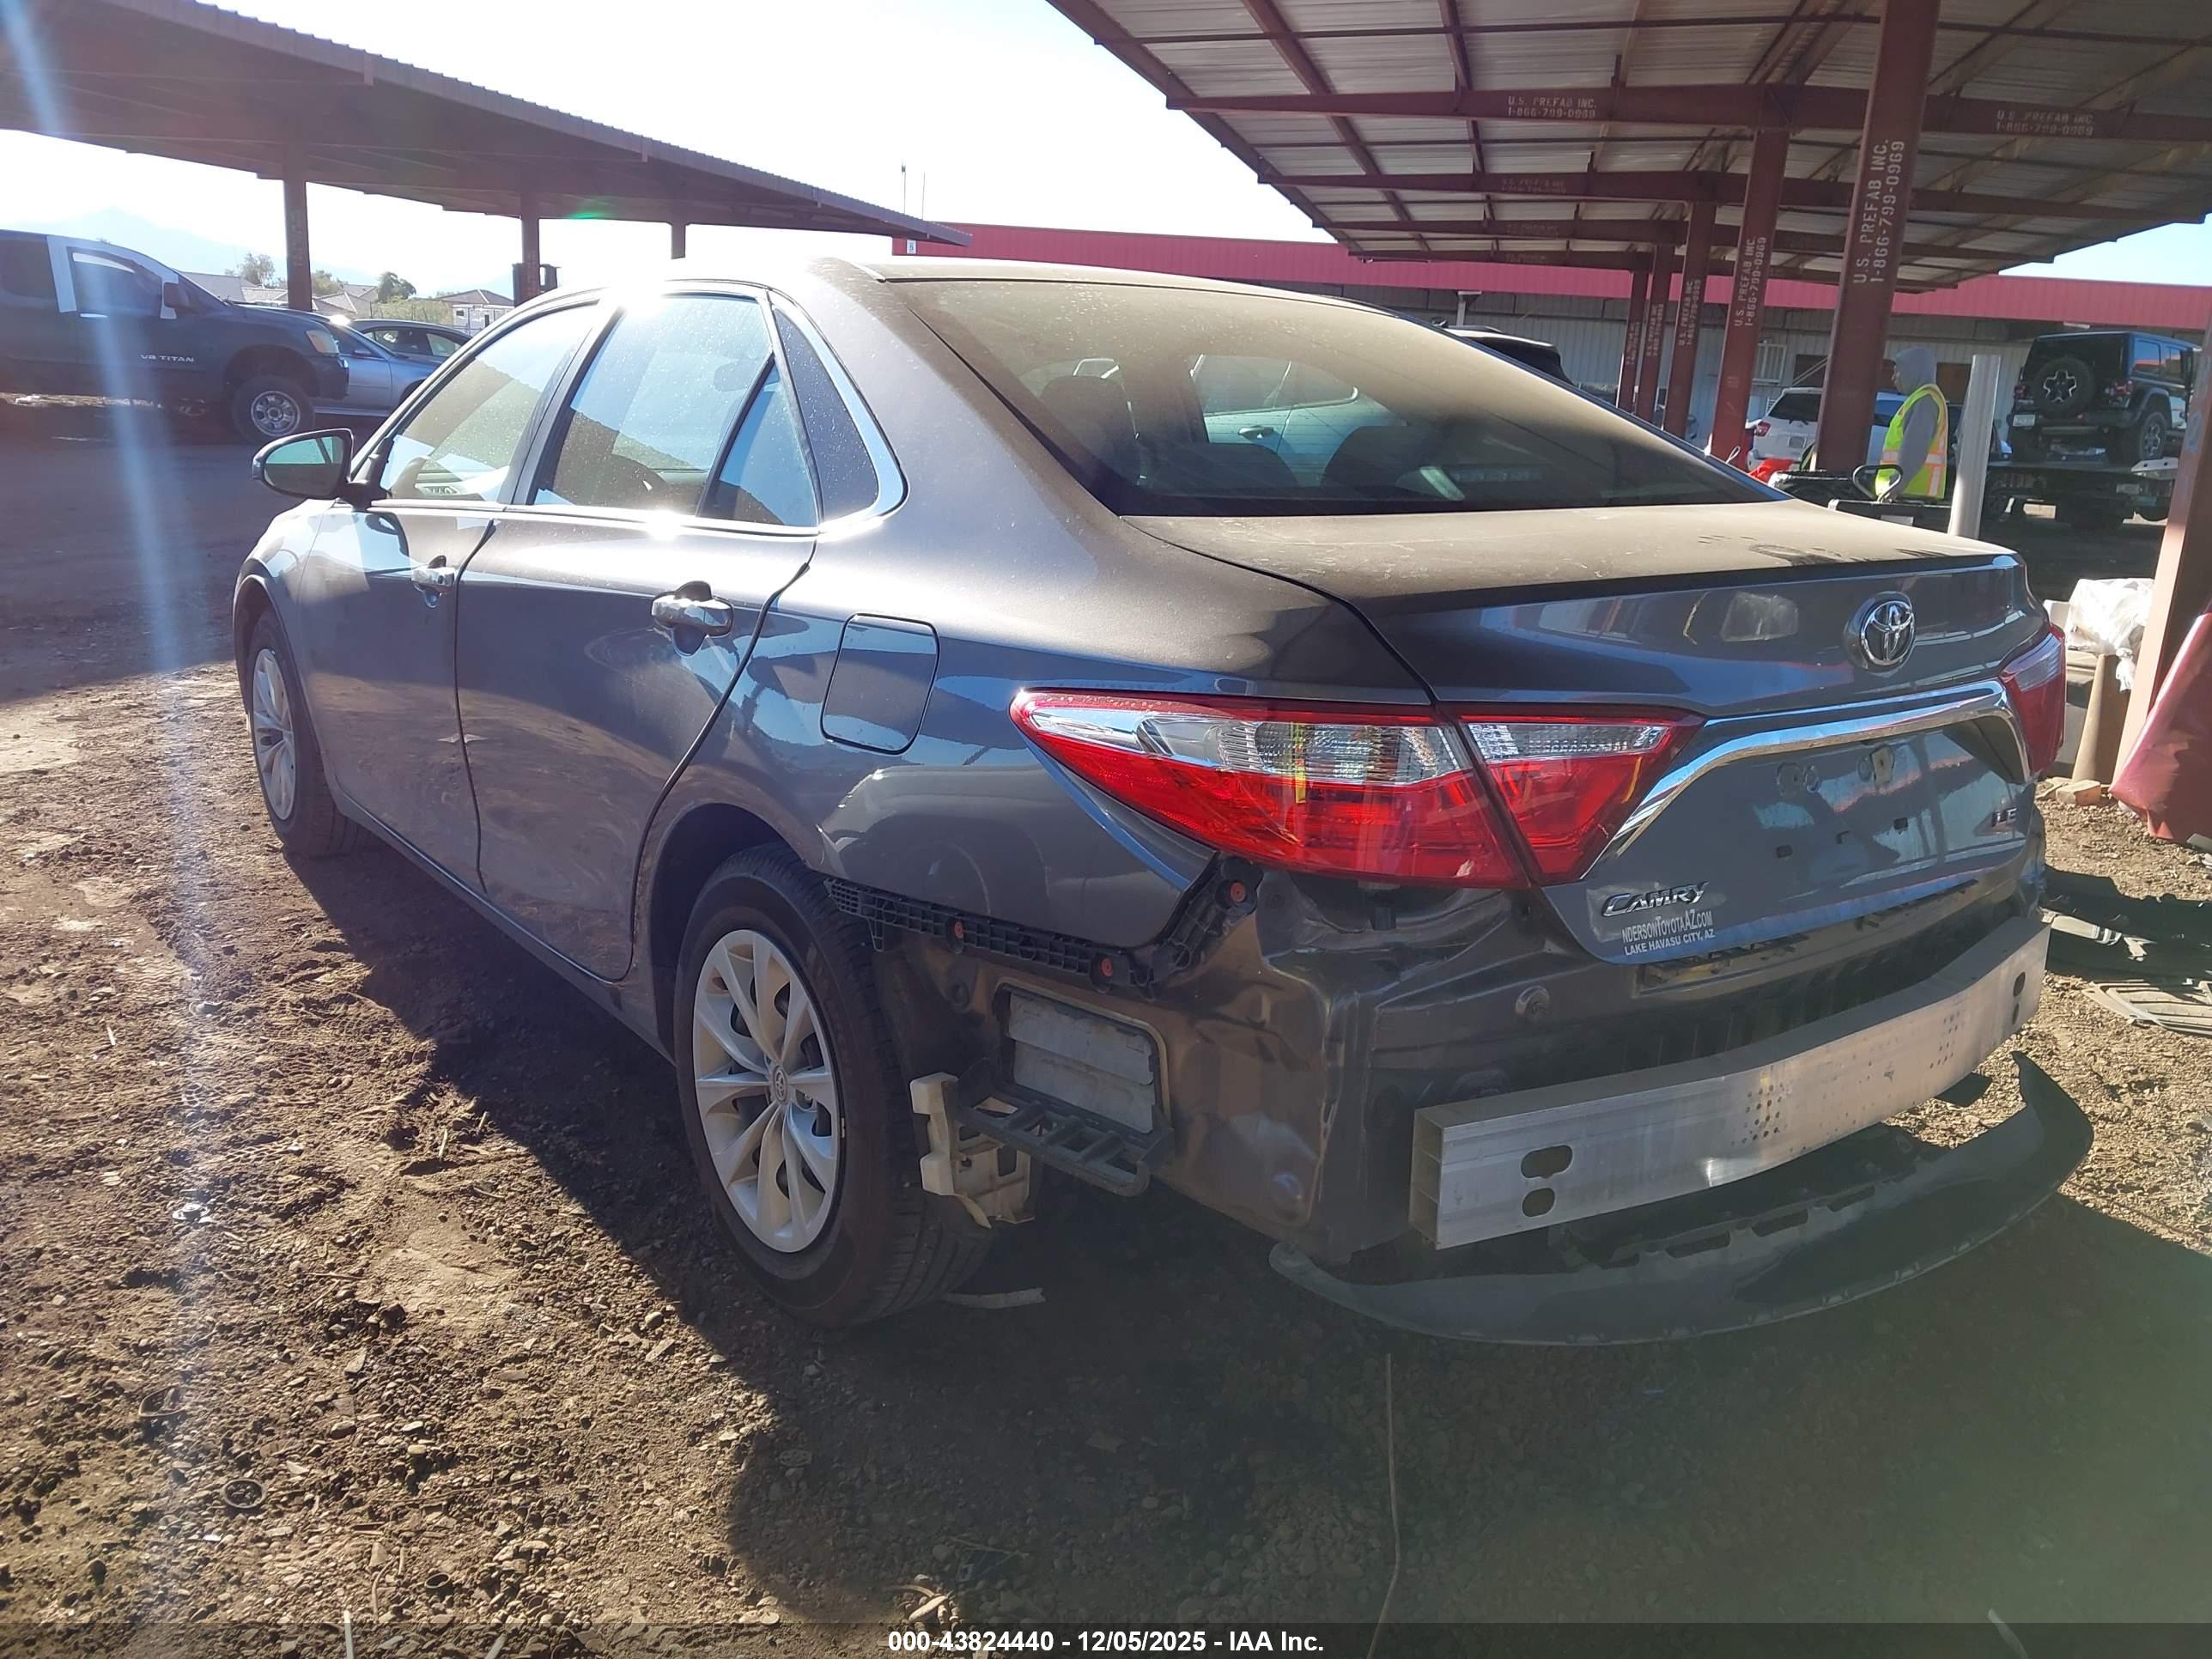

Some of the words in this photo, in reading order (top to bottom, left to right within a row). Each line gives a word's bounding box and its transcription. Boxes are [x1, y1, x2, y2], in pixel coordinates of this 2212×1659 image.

[1870, 139, 1889, 172] INC.
[1859, 179, 1882, 244] PREFAB
[1738, 260, 1753, 301] PREFAB
[1602, 881, 1709, 916] CAMRY
[1624, 943, 1648, 956] LAKE
[1648, 936, 1681, 951] HAVASU
[1682, 931, 1704, 944] CITY,
[1705, 928, 1717, 939] AZ
